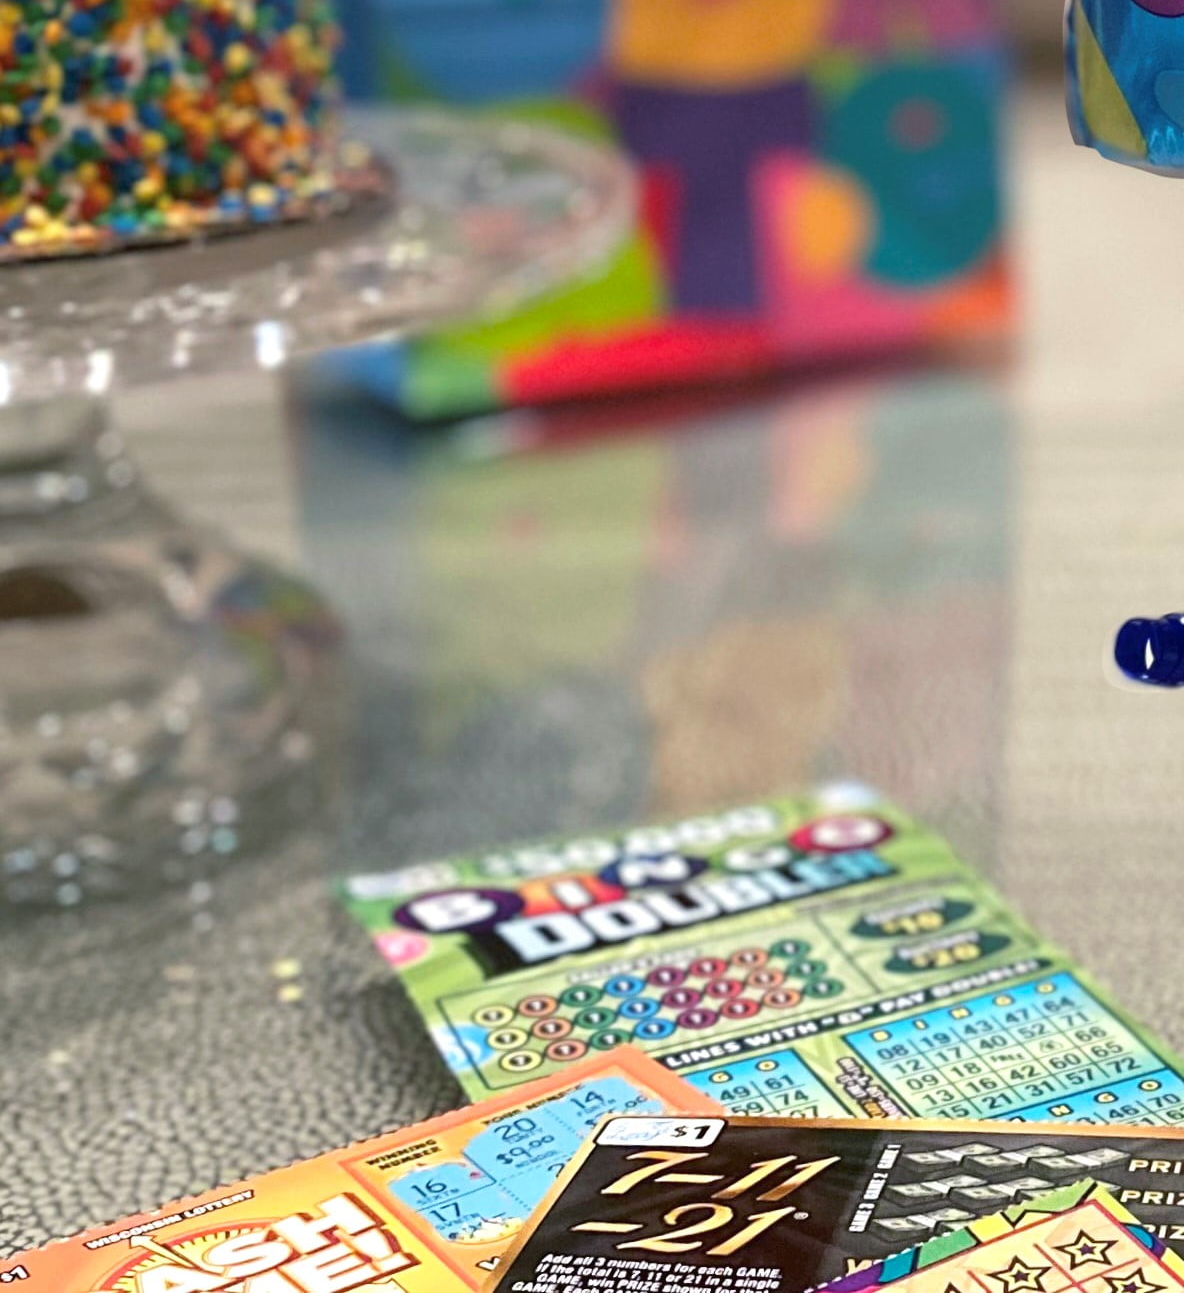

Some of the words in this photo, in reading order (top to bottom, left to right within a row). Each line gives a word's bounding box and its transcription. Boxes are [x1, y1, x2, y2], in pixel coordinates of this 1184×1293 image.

[499, 850, 894, 963] DOUBLER
[665, 1041, 743, 1068] LINES
[745, 1021, 817, 1047] WITH
[879, 990, 926, 1013] PAY
[877, 1044, 910, 1060] 08
[920, 1033, 951, 1049] 19
[963, 1020, 993, 1036] 43
[1004, 1009, 1031, 1024] 47
[891, 1059, 924, 1075] 12
[936, 1047, 965, 1062] 17
[979, 1035, 1007, 1051] 40
[1017, 1023, 1047, 1039] 52
[1063, 1012, 1091, 1027] 71
[720, 1085, 750, 1101] 49
[765, 1074, 794, 1090] 61
[905, 1075, 939, 1091] 09
[951, 1062, 982, 1079] 18
[922, 1089, 955, 1106] 13
[967, 1077, 998, 1094] 16
[1009, 1065, 1042, 1081] 42
[1049, 1054, 1081, 1071] 60
[1091, 1042, 1123, 1058] 65
[939, 1105, 968, 1118] 15
[982, 1092, 1013, 1109] 21
[1024, 1081, 1055, 1097] 31
[1064, 1069, 1095, 1085] 57
[1106, 1057, 1141, 1074] 72
[571, 1091, 605, 1110] 14
[776, 1090, 809, 1105] 74
[1108, 1104, 1139, 1120] 46
[1147, 1093, 1180, 1108] 70
[494, 1117, 536, 1141] 20
[366, 1139, 437, 1166] WINNING
[379, 1146, 442, 1171] NUMBER
[411, 1178, 447, 1198] 16
[85, 1214, 183, 1250] WISCONSIN
[184, 1189, 254, 1218] LOTTERY
[430, 1202, 462, 1222] 17
[535, 1263, 549, 1273] If
[550, 1264, 575, 1274] the
[577, 1266, 611, 1276] total
[613, 1268, 628, 1278] is
[647, 1271, 662, 1281] 11
[665, 1274, 682, 1283] or
[684, 1274, 702, 1284] 21
[705, 1276, 719, 1286] in
[722, 1278, 732, 1287] a
[734, 1278, 780, 1290] single
[542, 1254, 573, 1264] Add
[573, 1257, 594, 1266] all
[595, 1257, 606, 1267] 3
[607, 1259, 671, 1272] numbers
[674, 1263, 696, 1273] for
[698, 1266, 733, 1276] each
[587, 1277, 615, 1289] win
[617, 1280, 661, 1292] PRIZE
[662, 1283, 711, 1293] shown
